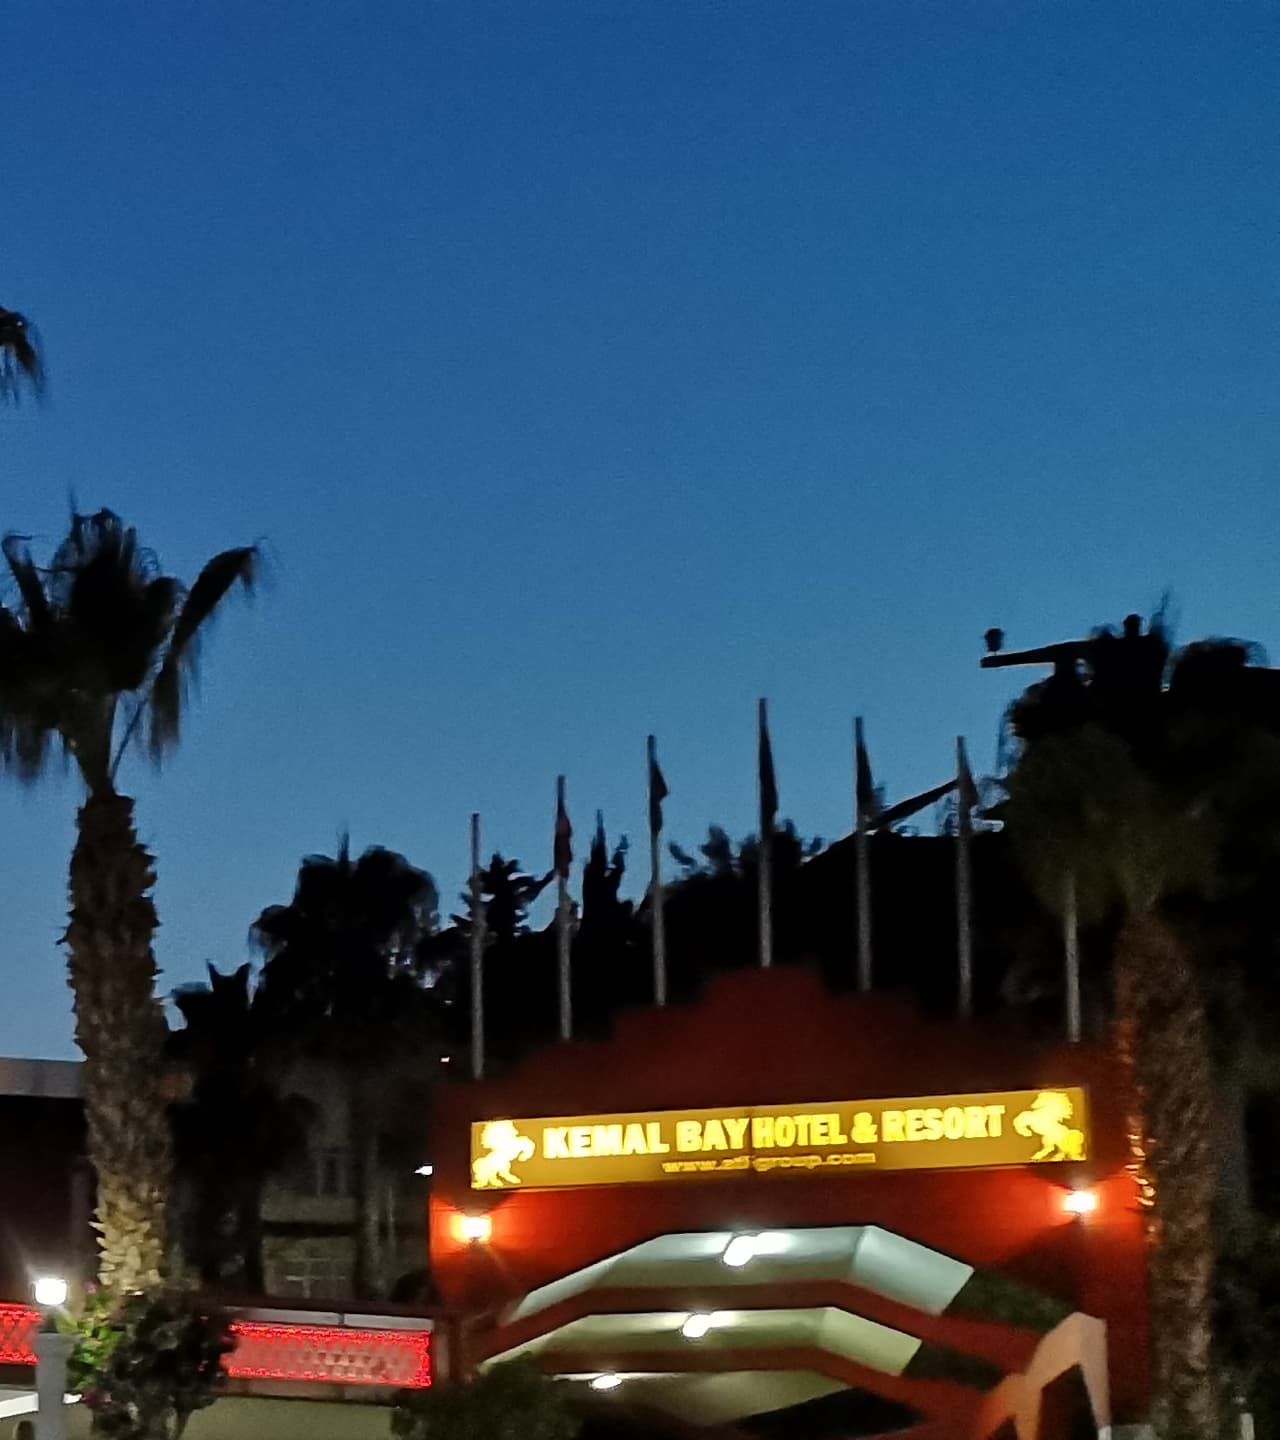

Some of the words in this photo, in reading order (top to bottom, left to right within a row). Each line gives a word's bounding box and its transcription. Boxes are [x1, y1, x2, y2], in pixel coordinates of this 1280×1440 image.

[543, 1122, 670, 1159] KEMAL
[676, 1118, 749, 1152] BAY
[752, 1113, 847, 1148] HOTEL
[851, 1112, 878, 1143] &
[882, 1105, 1005, 1142] RESORT
